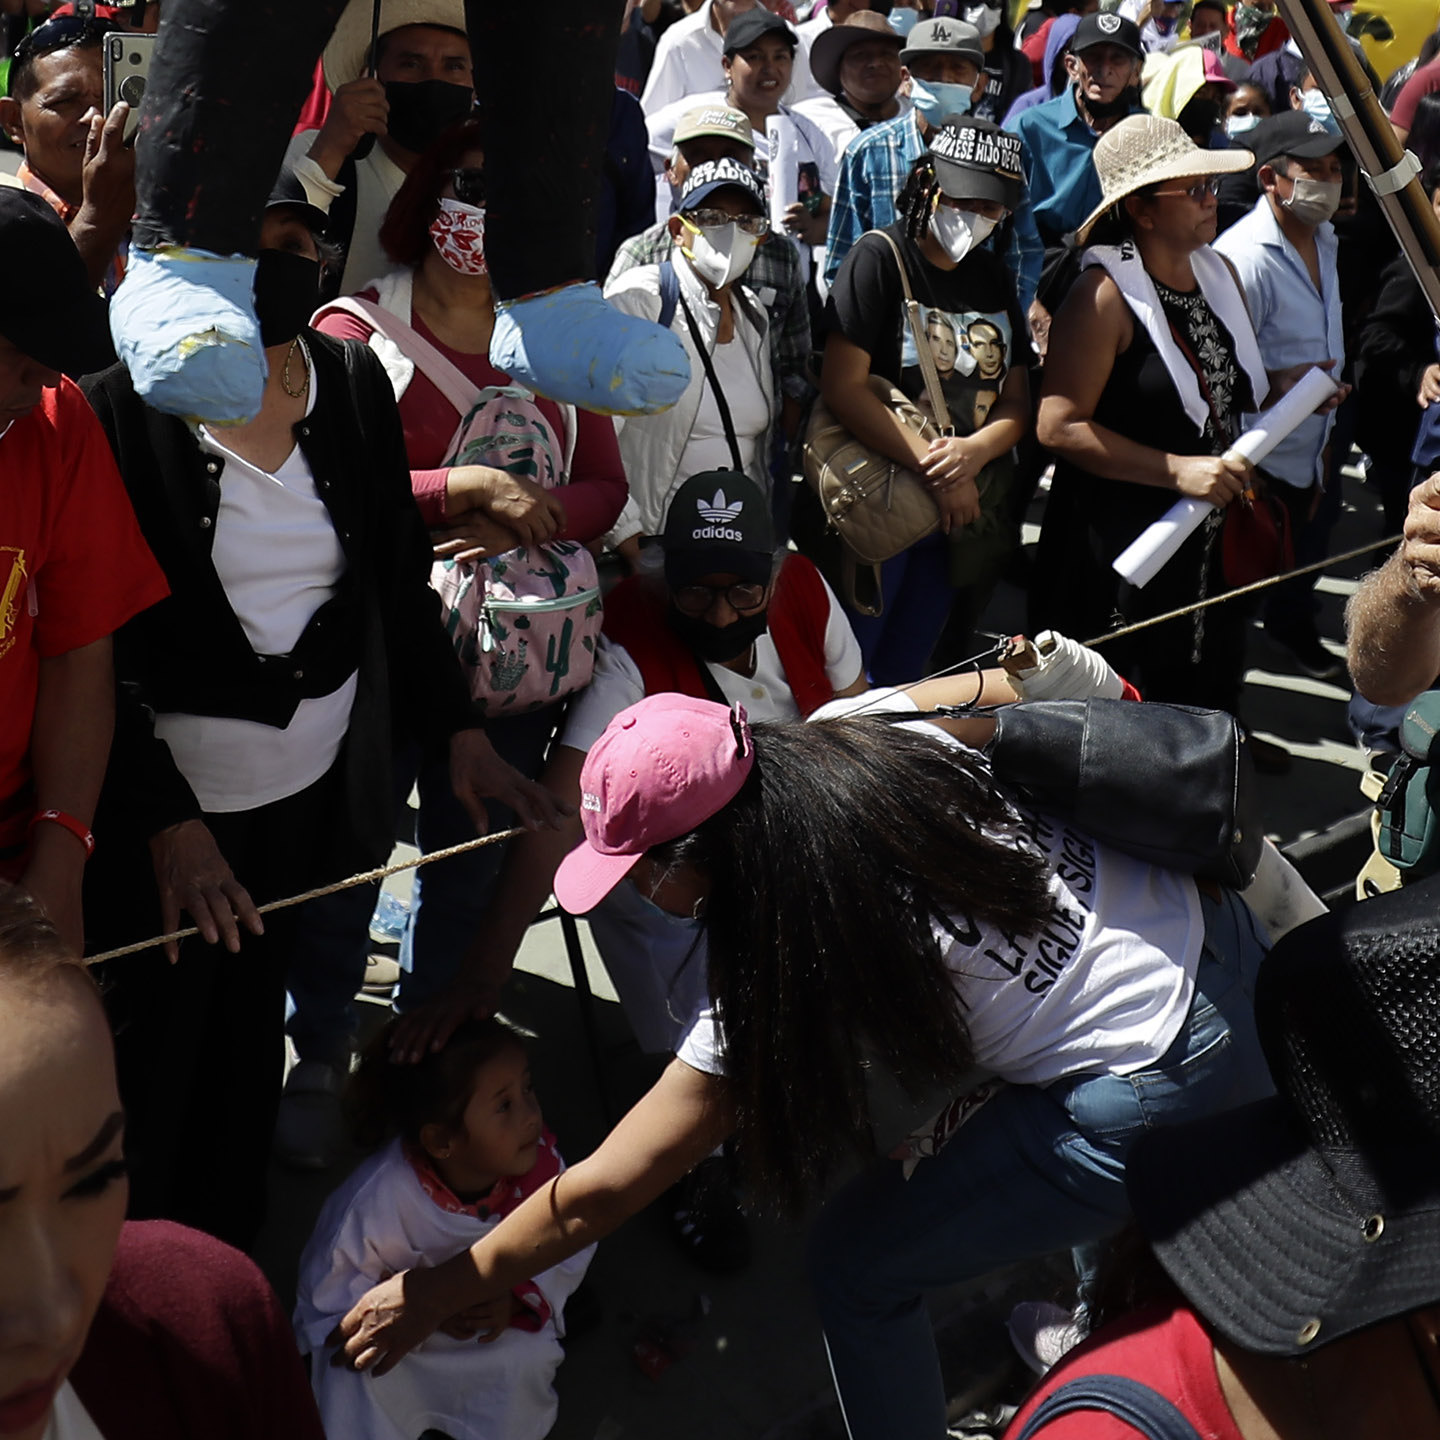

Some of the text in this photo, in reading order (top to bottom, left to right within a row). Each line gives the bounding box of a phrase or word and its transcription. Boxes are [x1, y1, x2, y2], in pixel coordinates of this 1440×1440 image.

[959, 128, 976, 141] ES
[979, 131, 994, 147] LA
[954, 139, 975, 161] ESE
[975, 143, 1001, 165] HIJO
[691, 160, 715, 178] NO
[718, 157, 732, 169] A
[692, 526, 743, 542] adidas
